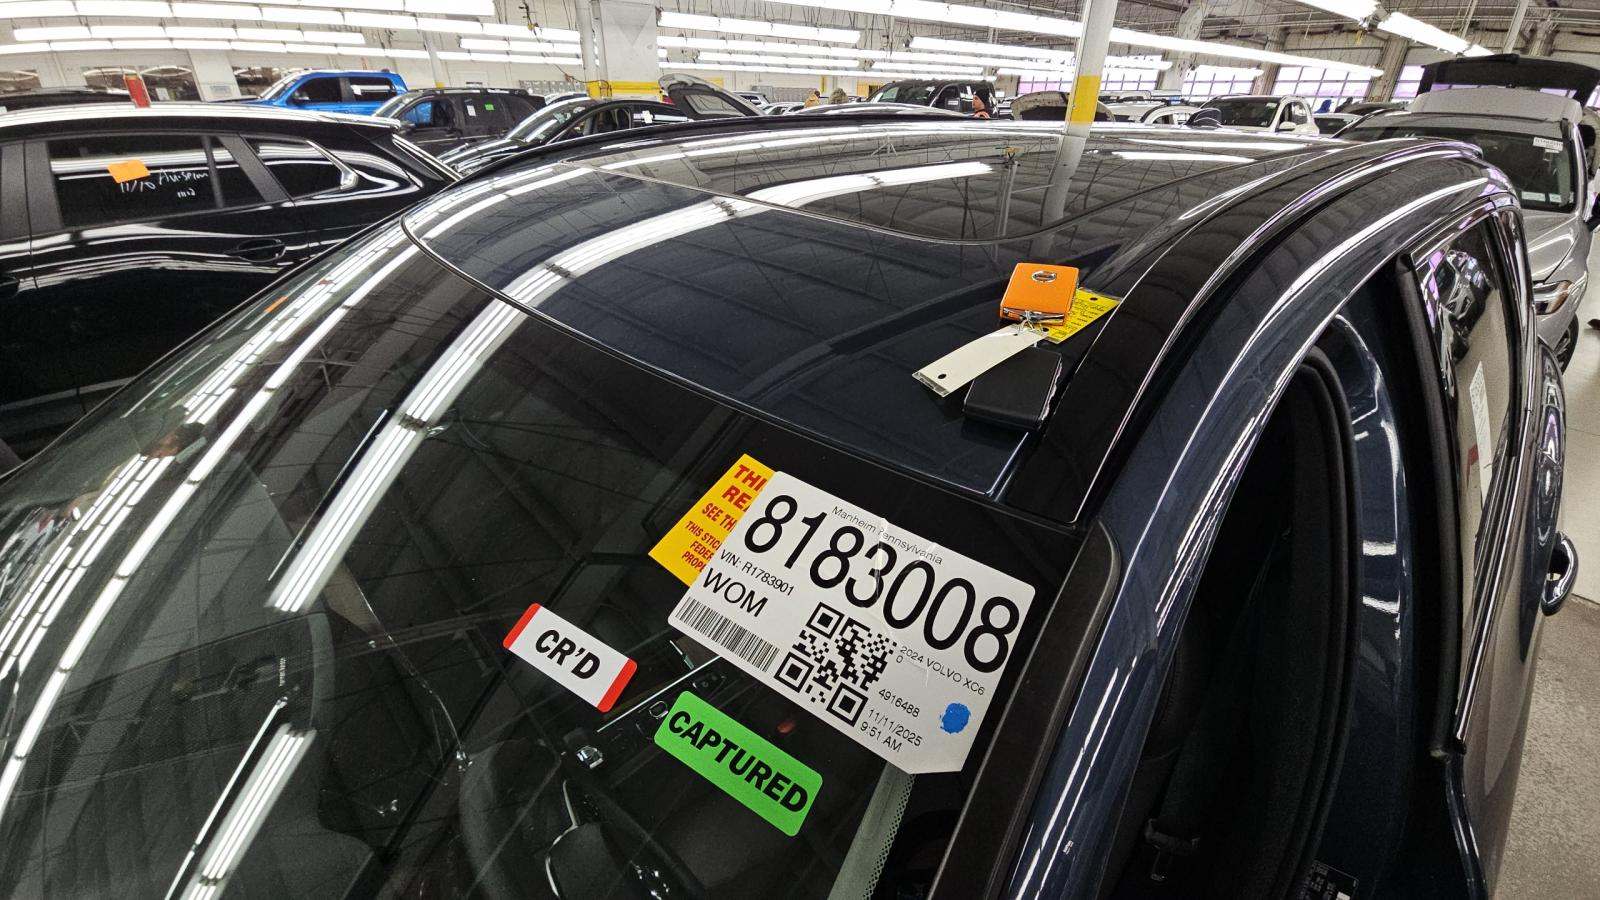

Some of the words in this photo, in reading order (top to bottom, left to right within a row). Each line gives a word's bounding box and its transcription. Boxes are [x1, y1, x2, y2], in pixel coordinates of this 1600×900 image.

[702, 502, 723, 522] SEE
[720, 514, 738, 532] TH
[721, 485, 752, 512] RE
[685, 521, 704, 537] THIS
[832, 506, 877, 533] Manheim
[720, 549, 741, 568] VIN:
[741, 561, 794, 596] R1783901
[744, 494, 1020, 673] 8183008
[703, 568, 769, 618] WOM
[534, 629, 601, 680] CR'D
[900, 646, 924, 663] 2024
[926, 658, 962, 683] VOLVO
[962, 677, 986, 695] XC6
[878, 688, 920, 718] 4916488
[860, 721, 881, 741] 9:51
[883, 736, 902, 752] AM
[868, 709, 922, 747] 11/11/2025
[668, 710, 809, 813] CAPTURED
